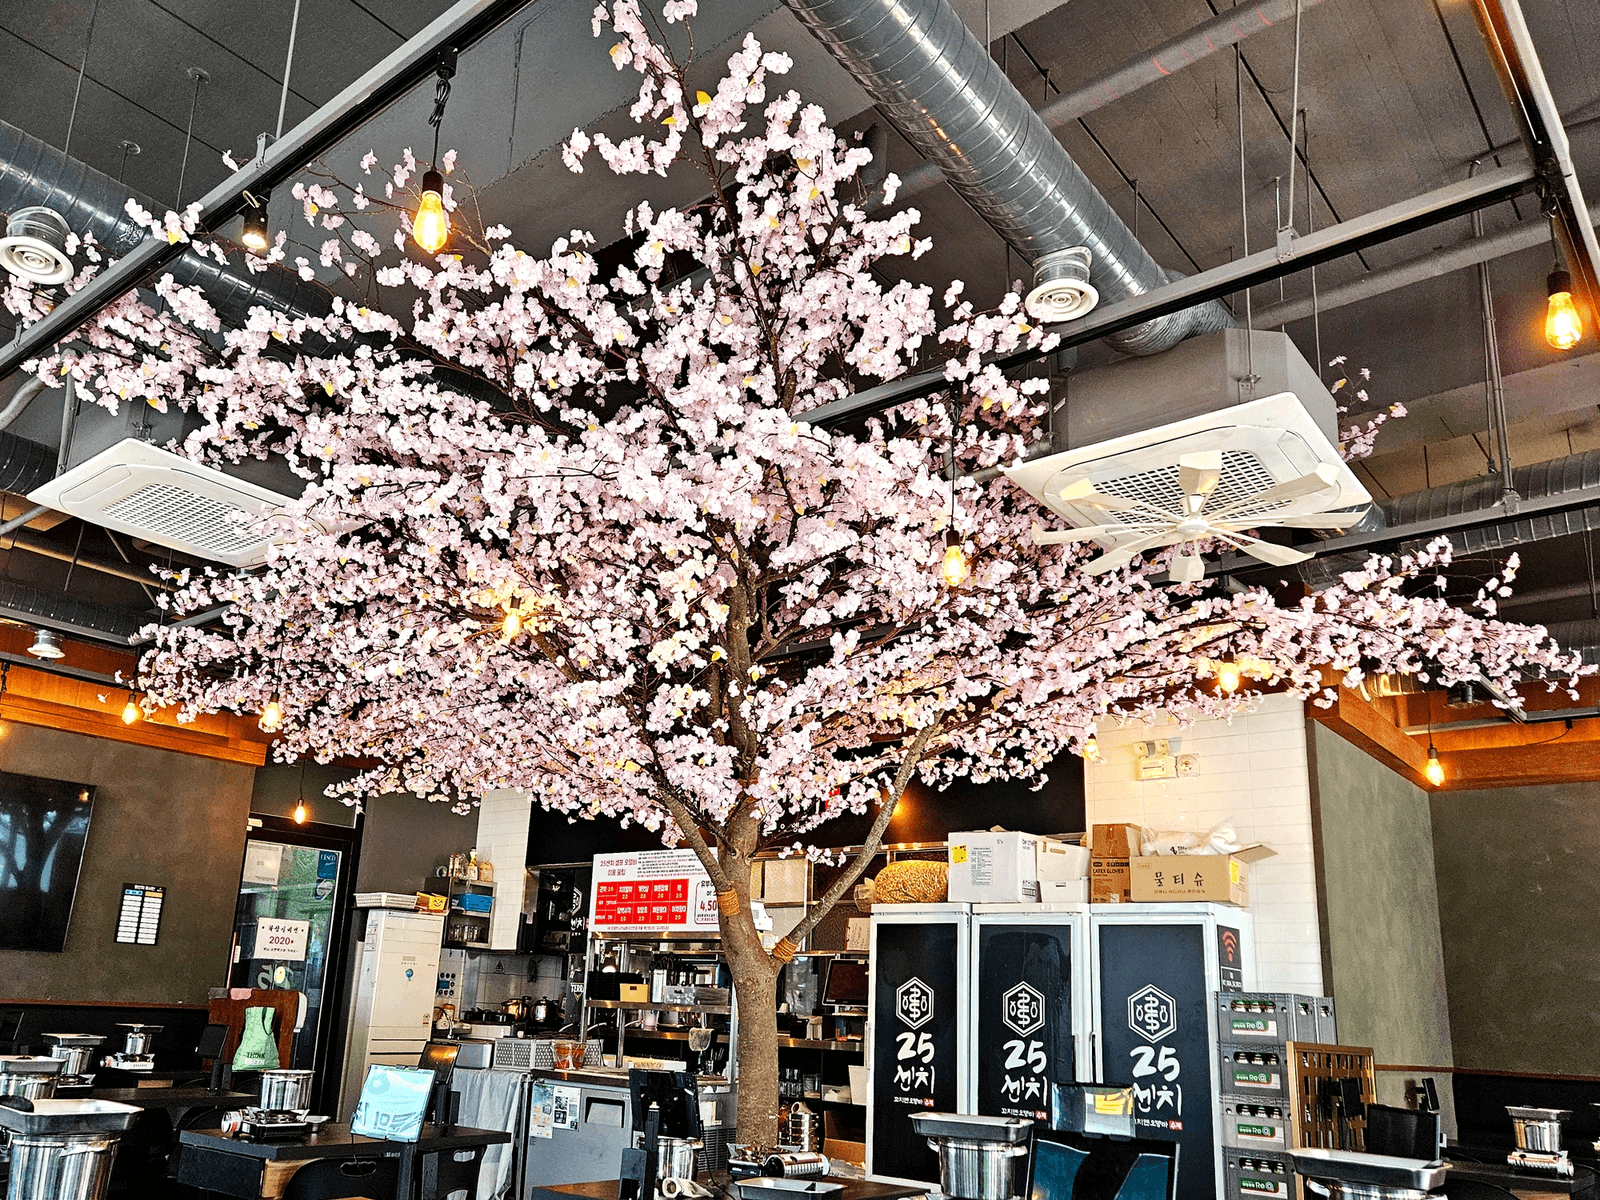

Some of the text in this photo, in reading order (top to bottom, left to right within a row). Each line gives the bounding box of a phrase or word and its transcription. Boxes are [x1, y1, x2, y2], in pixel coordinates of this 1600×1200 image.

[700, 900, 718, 912] 4,50
[896, 1031, 935, 1064] 25
[1003, 1039, 1047, 1074] 25
[1129, 1045, 1180, 1082] 25
[893, 1064, 935, 1094] 센치
[1000, 1074, 1048, 1107] 센치
[1132, 1082, 1182, 1117] 센치
